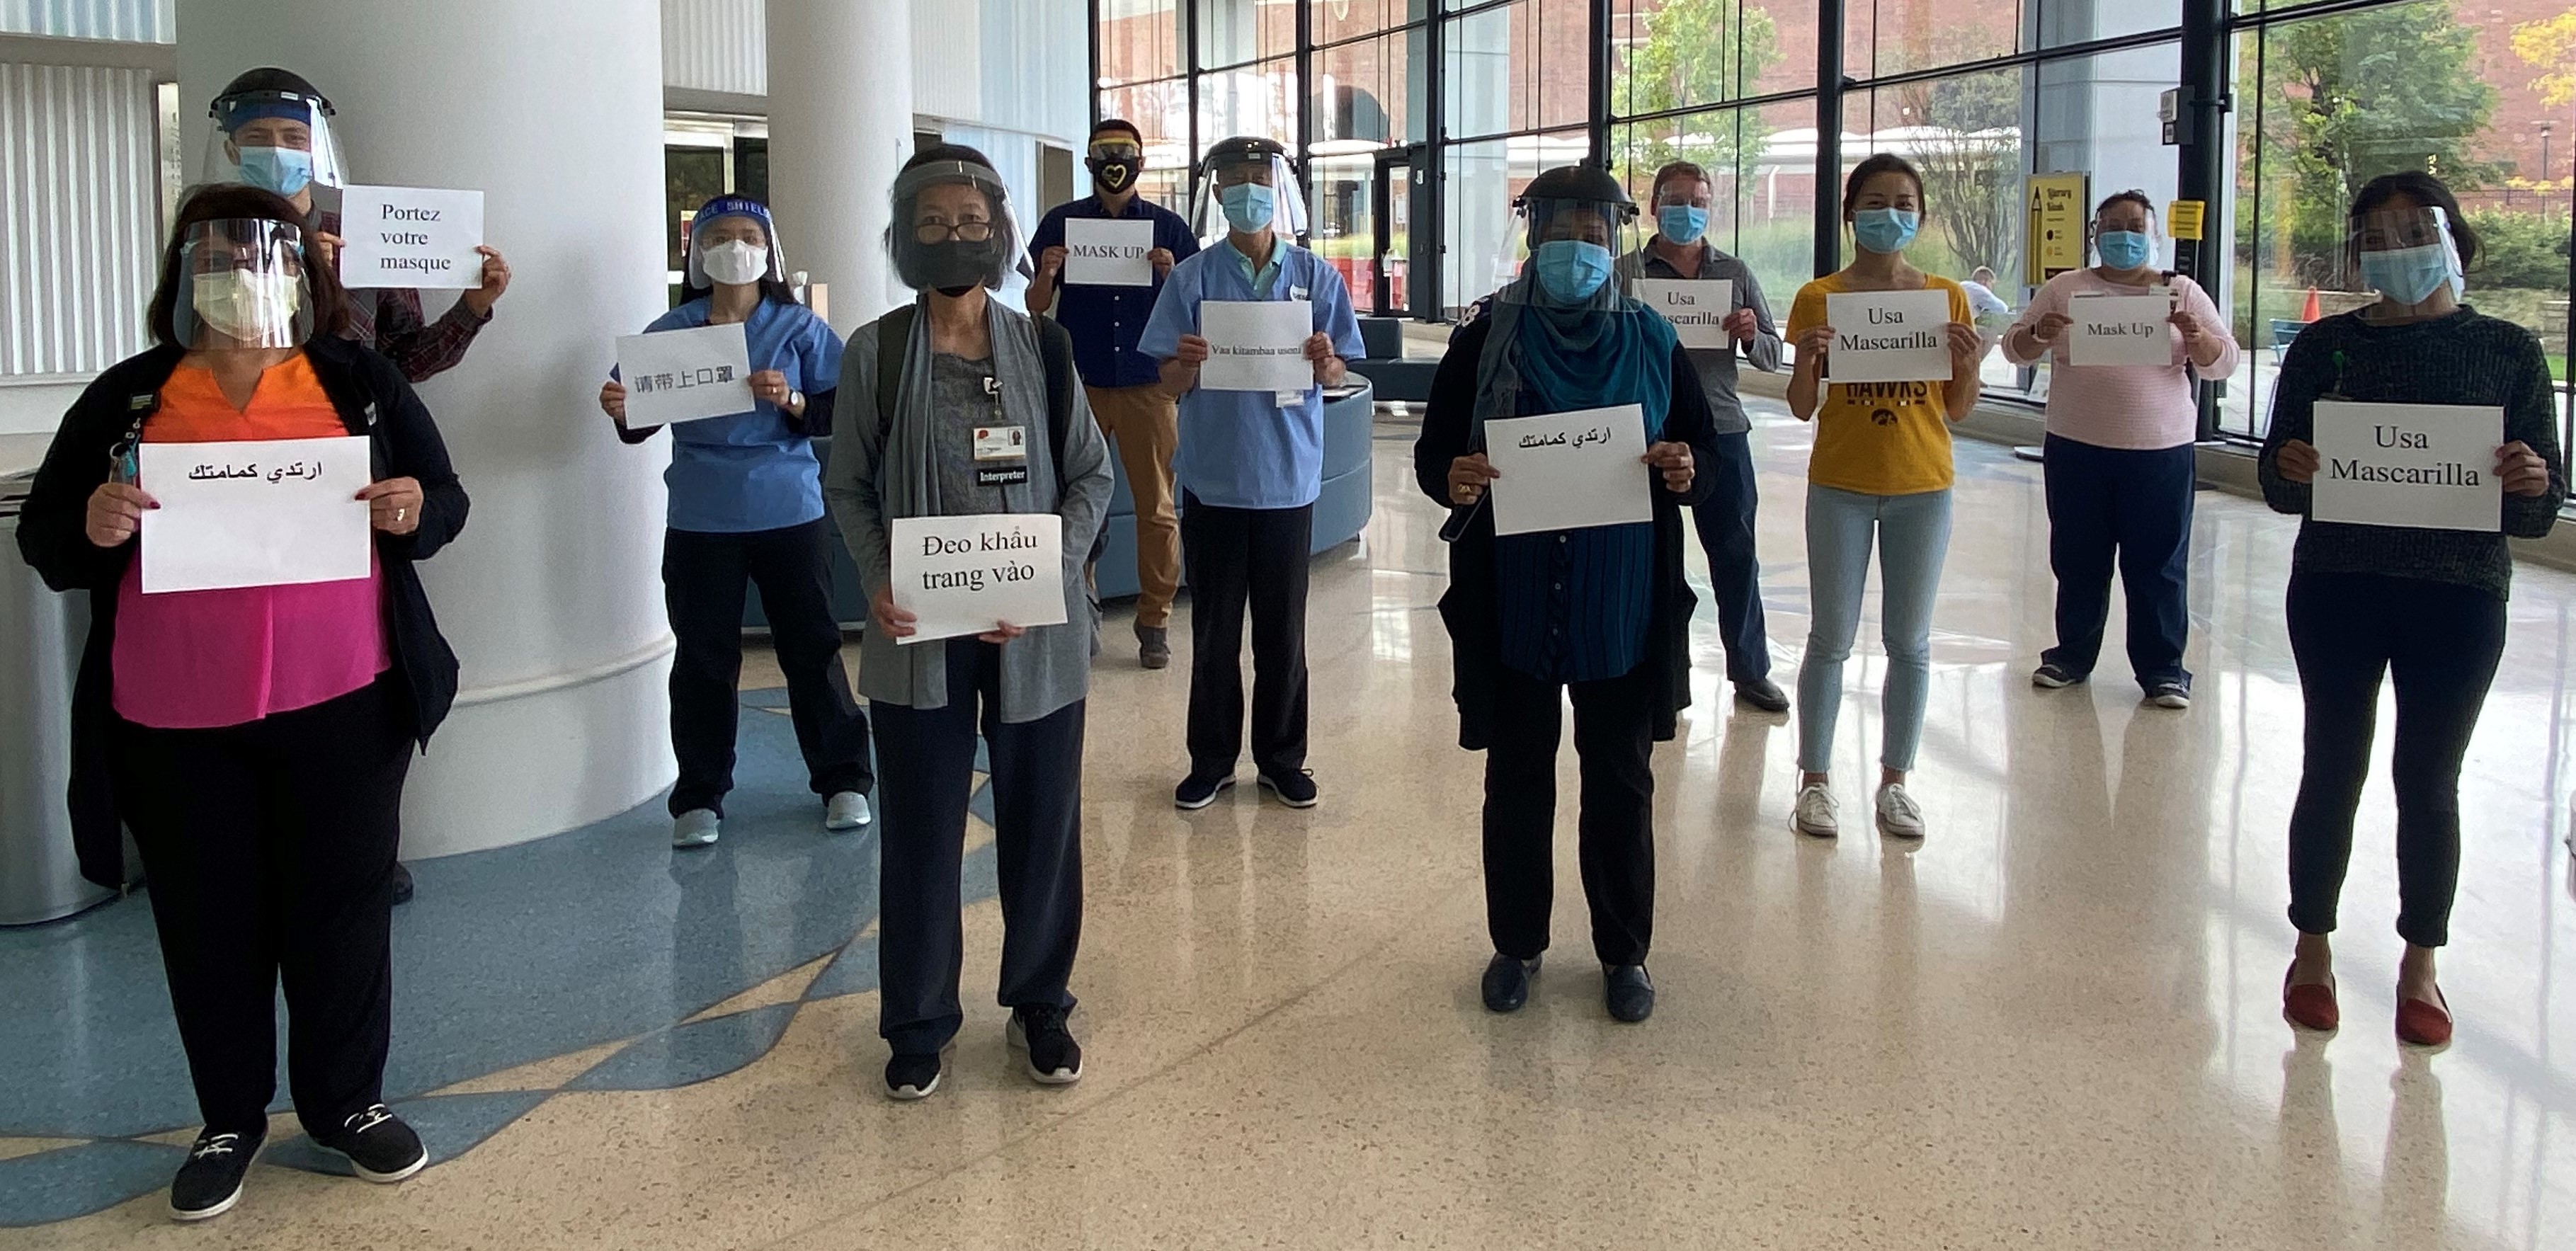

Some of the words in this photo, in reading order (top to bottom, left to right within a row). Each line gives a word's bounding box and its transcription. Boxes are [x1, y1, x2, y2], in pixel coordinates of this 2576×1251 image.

[382, 204, 440, 222] Portez
[380, 232, 428, 245] votre
[1073, 245, 1119, 258] MASK
[1124, 246, 1144, 259] UP
[380, 257, 451, 275] masque
[1668, 292, 1696, 305] Usa
[1660, 312, 1719, 326] scarilla
[1868, 307, 1904, 325] Usa
[2087, 322, 2127, 336] Mask
[2131, 322, 2154, 338] Up
[1212, 344, 1231, 355] Vaa
[1232, 344, 1275, 355] kitambaa
[1840, 331, 1937, 350] Mascarilla
[635, 365, 735, 393] 请带上口罩
[1518, 432, 1567, 448] كمامتك
[1571, 426, 1612, 449] ارتدي
[2374, 425, 2429, 450] Usa
[188, 463, 258, 480] كمامتك
[266, 462, 323, 484] ارتدي
[980, 470, 1025, 484] Interpreter
[2331, 458, 2481, 487] Mascarilla
[922, 535, 972, 556] Đeo
[923, 569, 985, 591] trang
[992, 560, 1035, 583] vào
